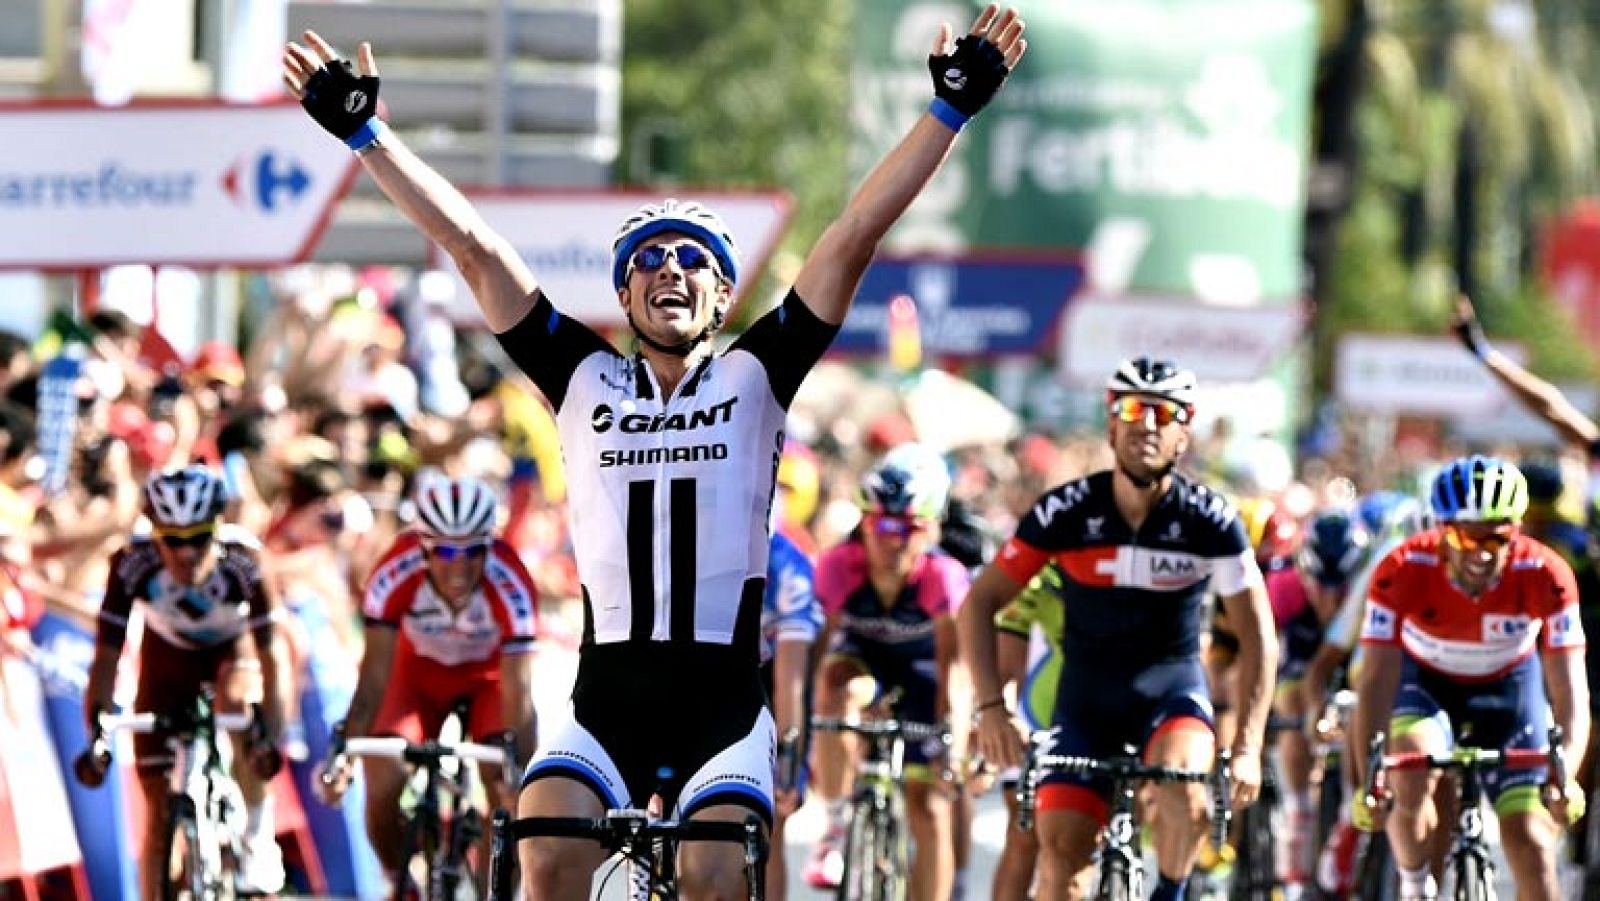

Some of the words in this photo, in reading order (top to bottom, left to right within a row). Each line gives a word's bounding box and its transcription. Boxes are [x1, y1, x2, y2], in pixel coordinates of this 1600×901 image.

[0, 159, 196, 206] arrefour
[619, 396, 738, 434] GIANT
[599, 443, 728, 467] SHIMANO
[1034, 479, 1092, 528] IAM
[1151, 556, 1195, 574] IAM
